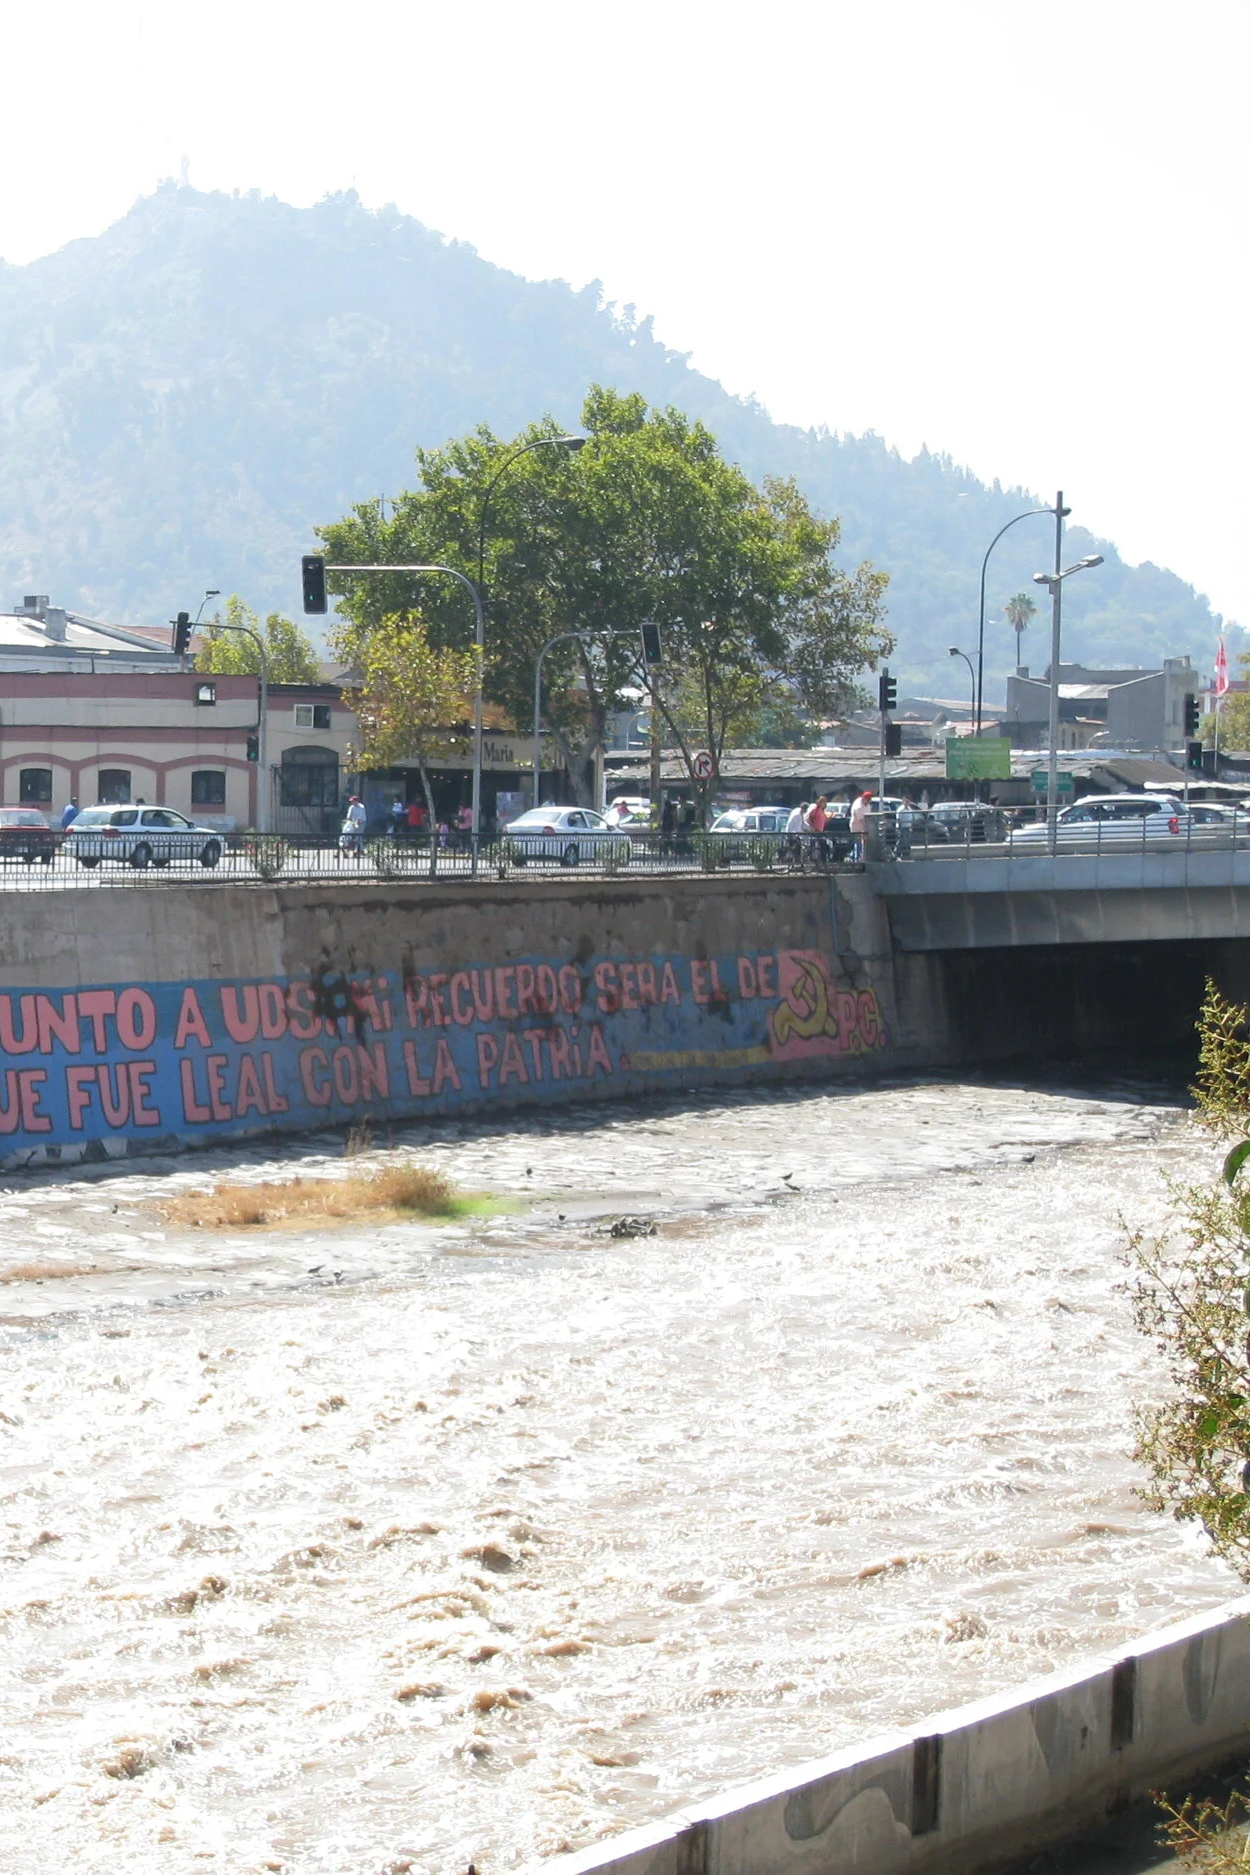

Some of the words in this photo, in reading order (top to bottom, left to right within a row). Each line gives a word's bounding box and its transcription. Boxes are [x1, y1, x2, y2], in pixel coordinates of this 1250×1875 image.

[174, 986, 213, 1049] A
[405, 963, 582, 1030] RECUERDO
[690, 959, 722, 1005] EL
[737, 954, 775, 998] DE
[66, 1061, 160, 1131] FUE
[180, 1052, 289, 1123] LEAL
[301, 1043, 391, 1106] CON
[404, 1038, 463, 1097] LA
